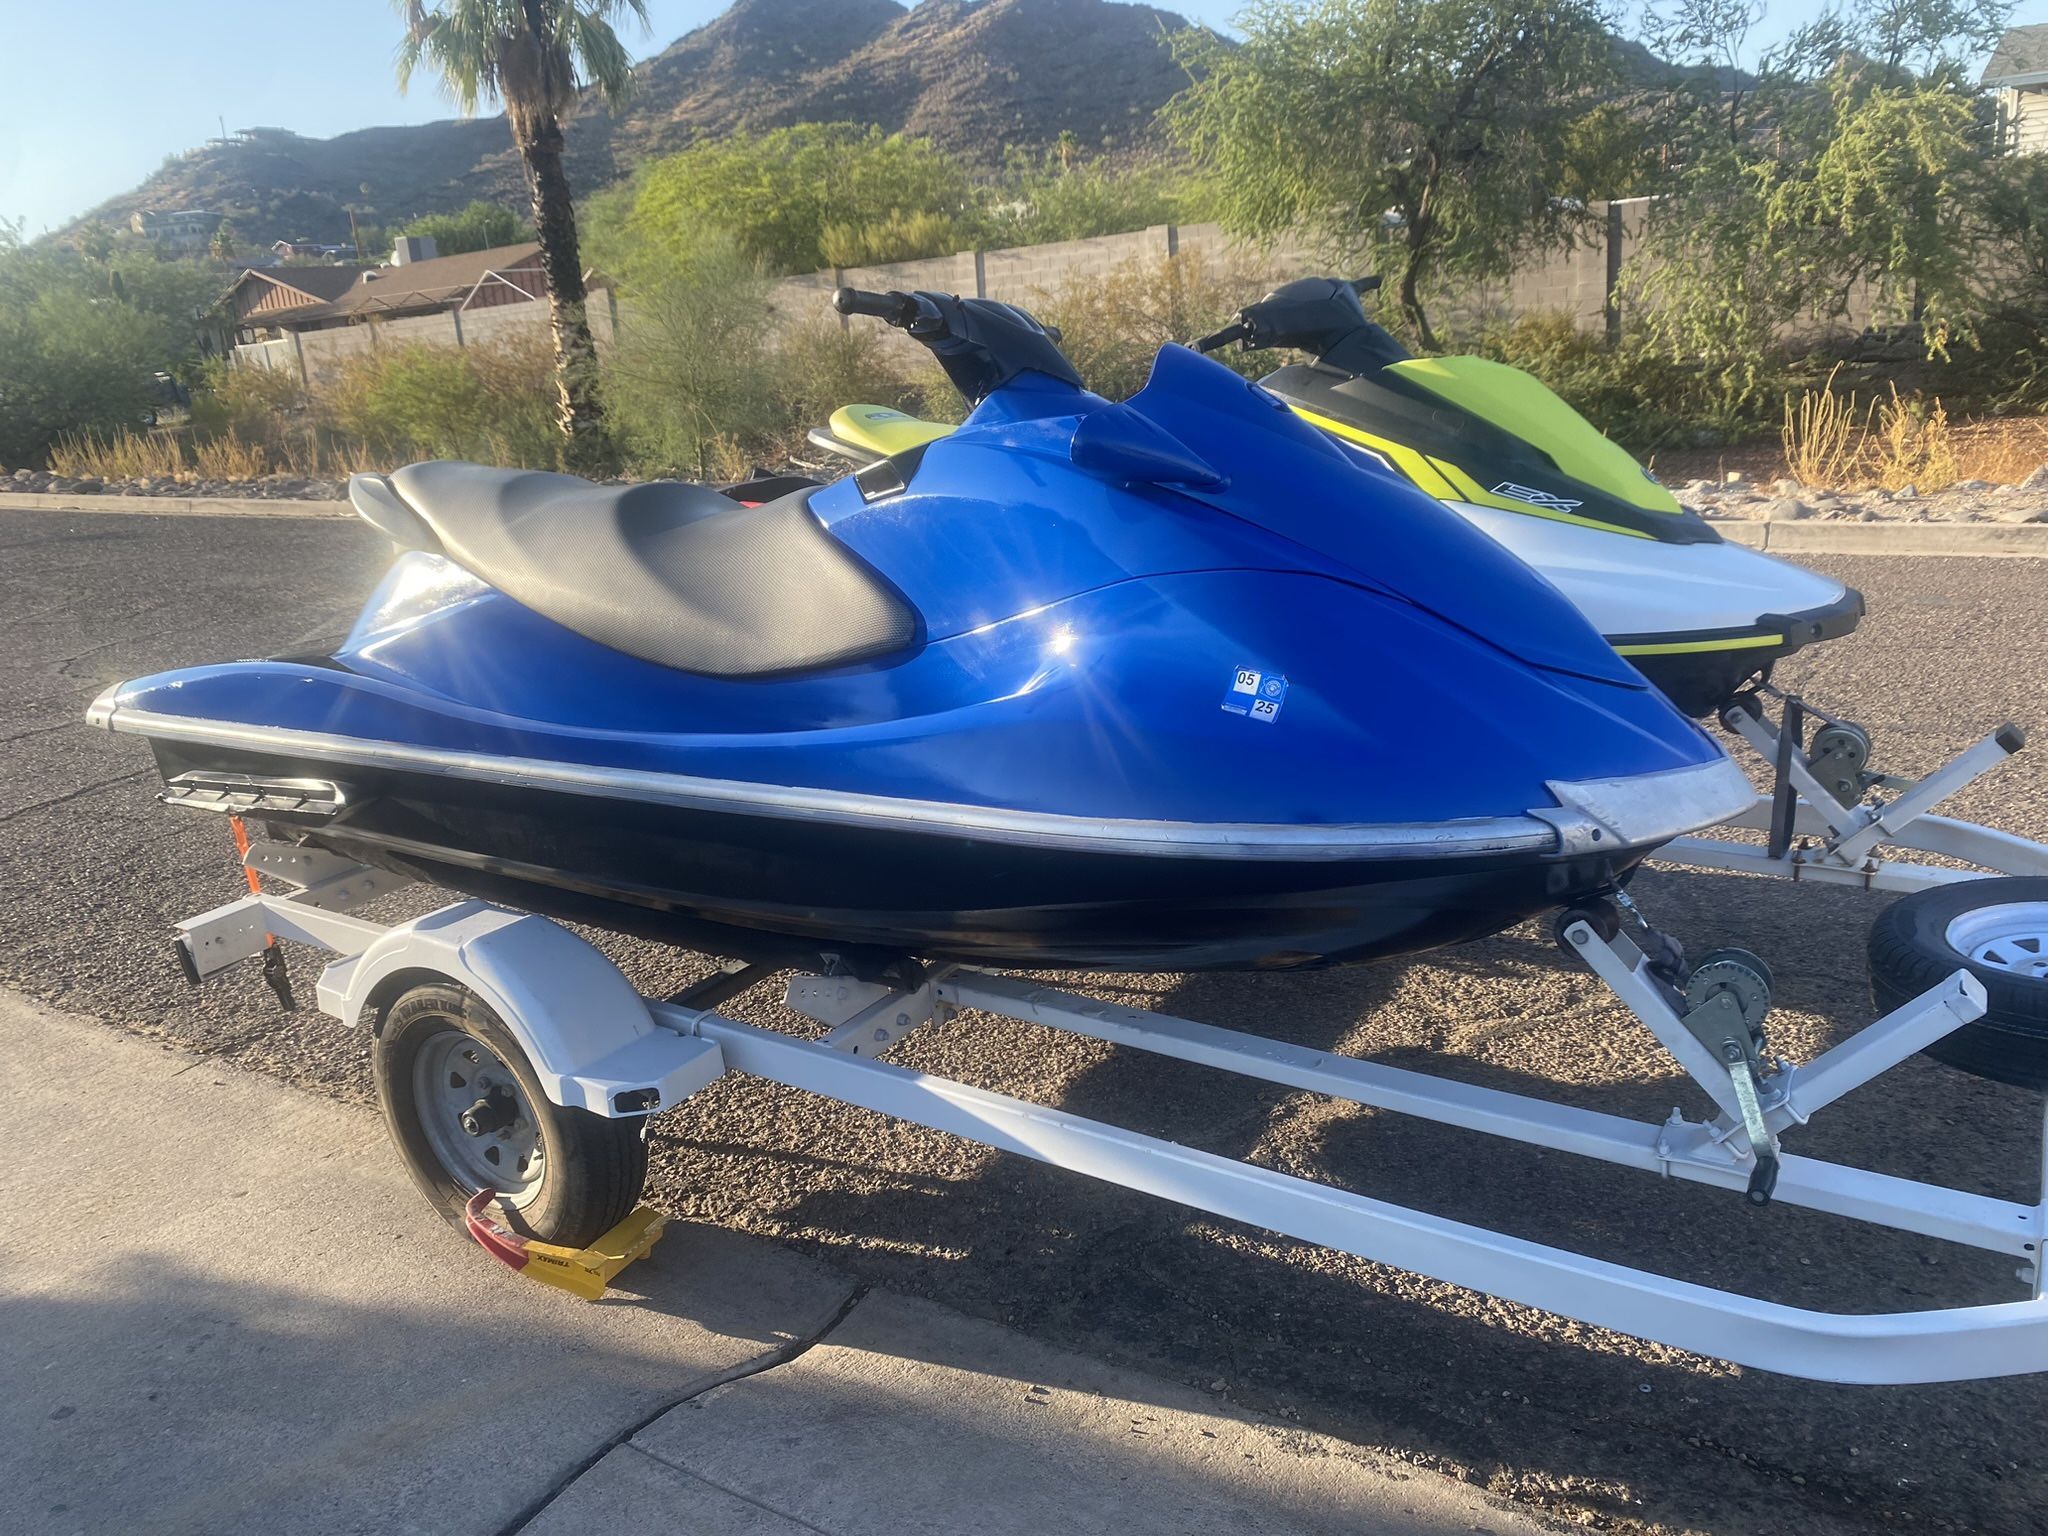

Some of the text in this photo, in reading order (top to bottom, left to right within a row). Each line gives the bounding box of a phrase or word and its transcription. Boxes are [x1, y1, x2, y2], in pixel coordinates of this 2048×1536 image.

[1490, 481, 1584, 513] EX
[1237, 671, 1255, 686] 05
[1255, 701, 1275, 715] 25
[537, 1254, 569, 1268] TRIMAX
